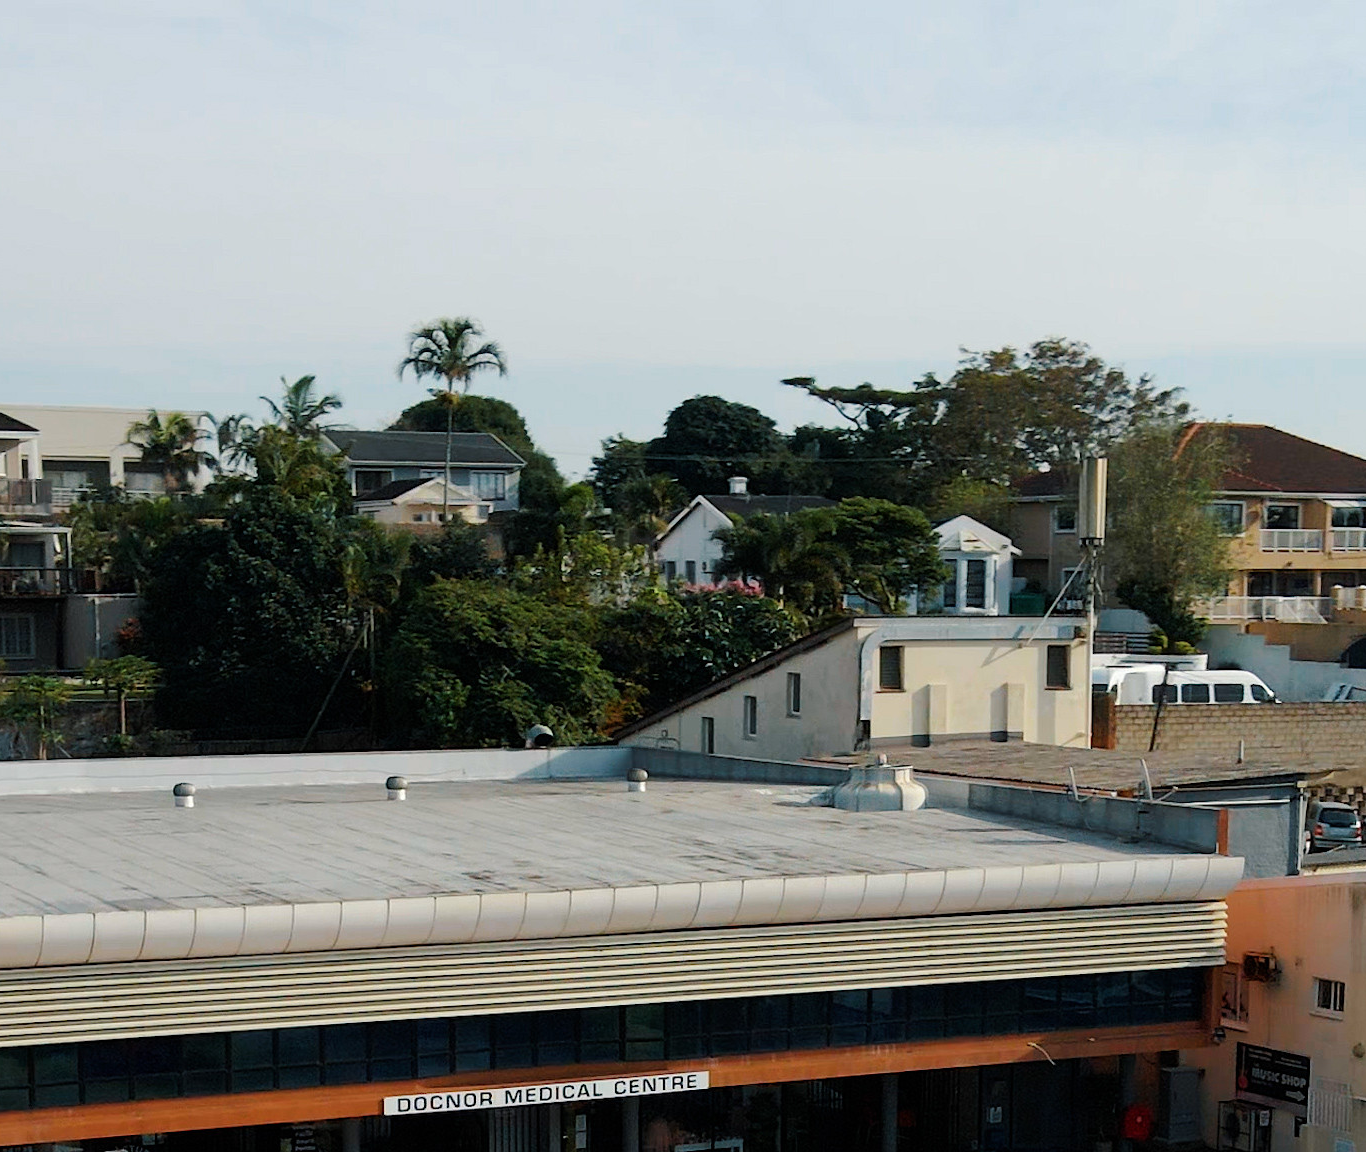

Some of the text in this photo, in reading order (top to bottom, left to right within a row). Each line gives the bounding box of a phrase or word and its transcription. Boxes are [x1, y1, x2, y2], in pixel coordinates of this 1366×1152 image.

[1251, 1067, 1307, 1088] MUSIC SHOP
[397, 1074, 698, 1112] DOCNOR MEDICAL CENTRE
